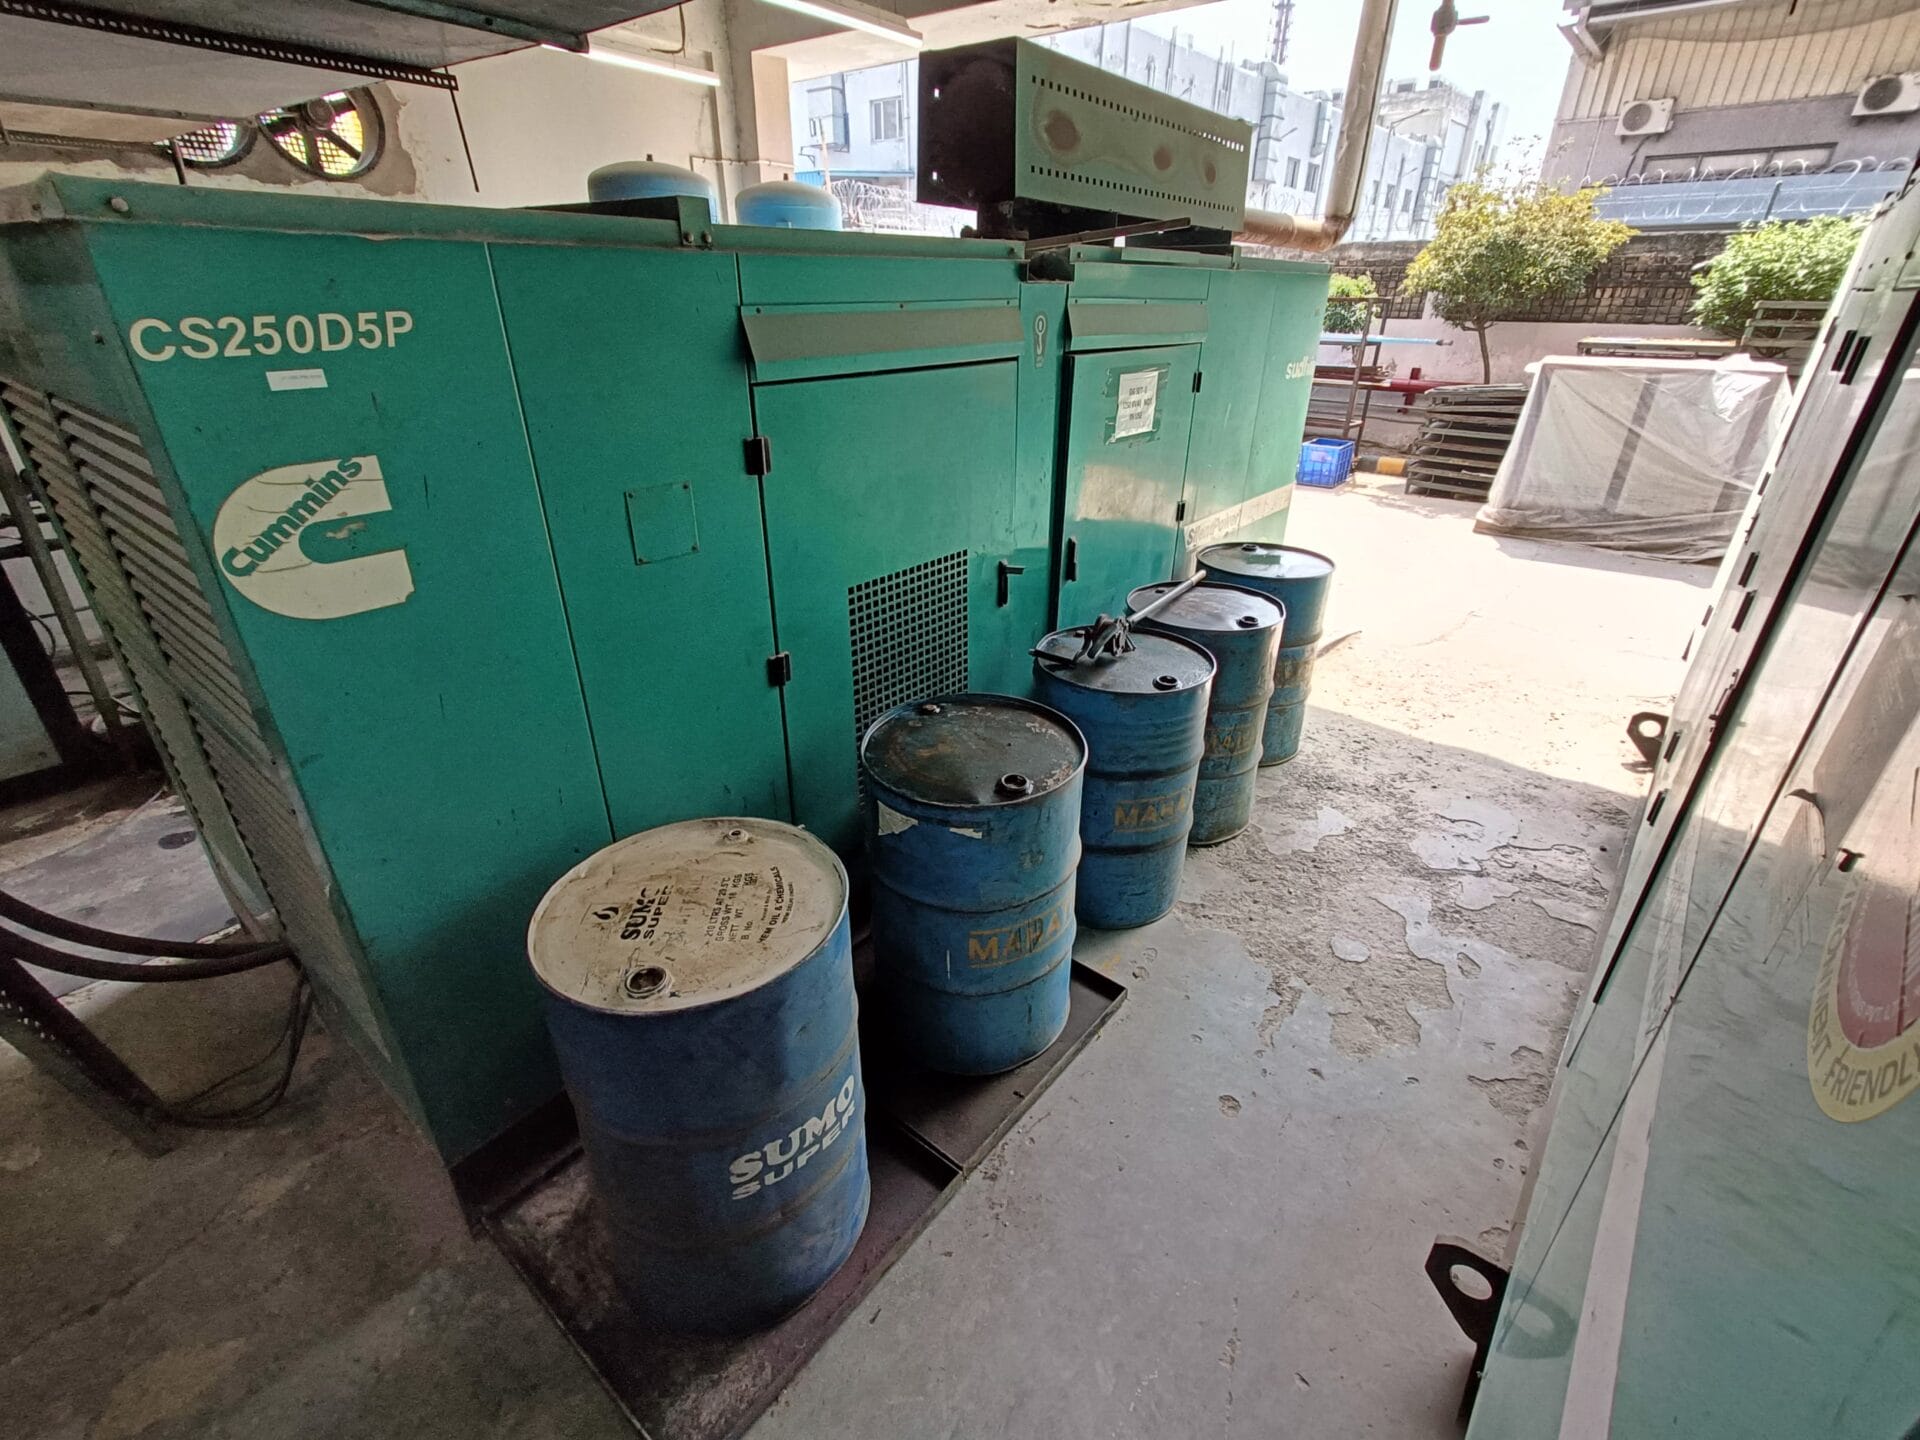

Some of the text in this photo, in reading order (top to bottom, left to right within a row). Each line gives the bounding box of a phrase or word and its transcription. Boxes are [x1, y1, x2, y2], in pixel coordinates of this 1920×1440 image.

[129, 310, 414, 362] CS250D5P
[221, 457, 363, 577] Cummins
[732, 873, 743, 888] KGS
[770, 865, 785, 904] CHEMICALS
[769, 913, 781, 926] OIL
[729, 1074, 855, 1184] SUMO
[731, 1100, 856, 1200] SUPER
